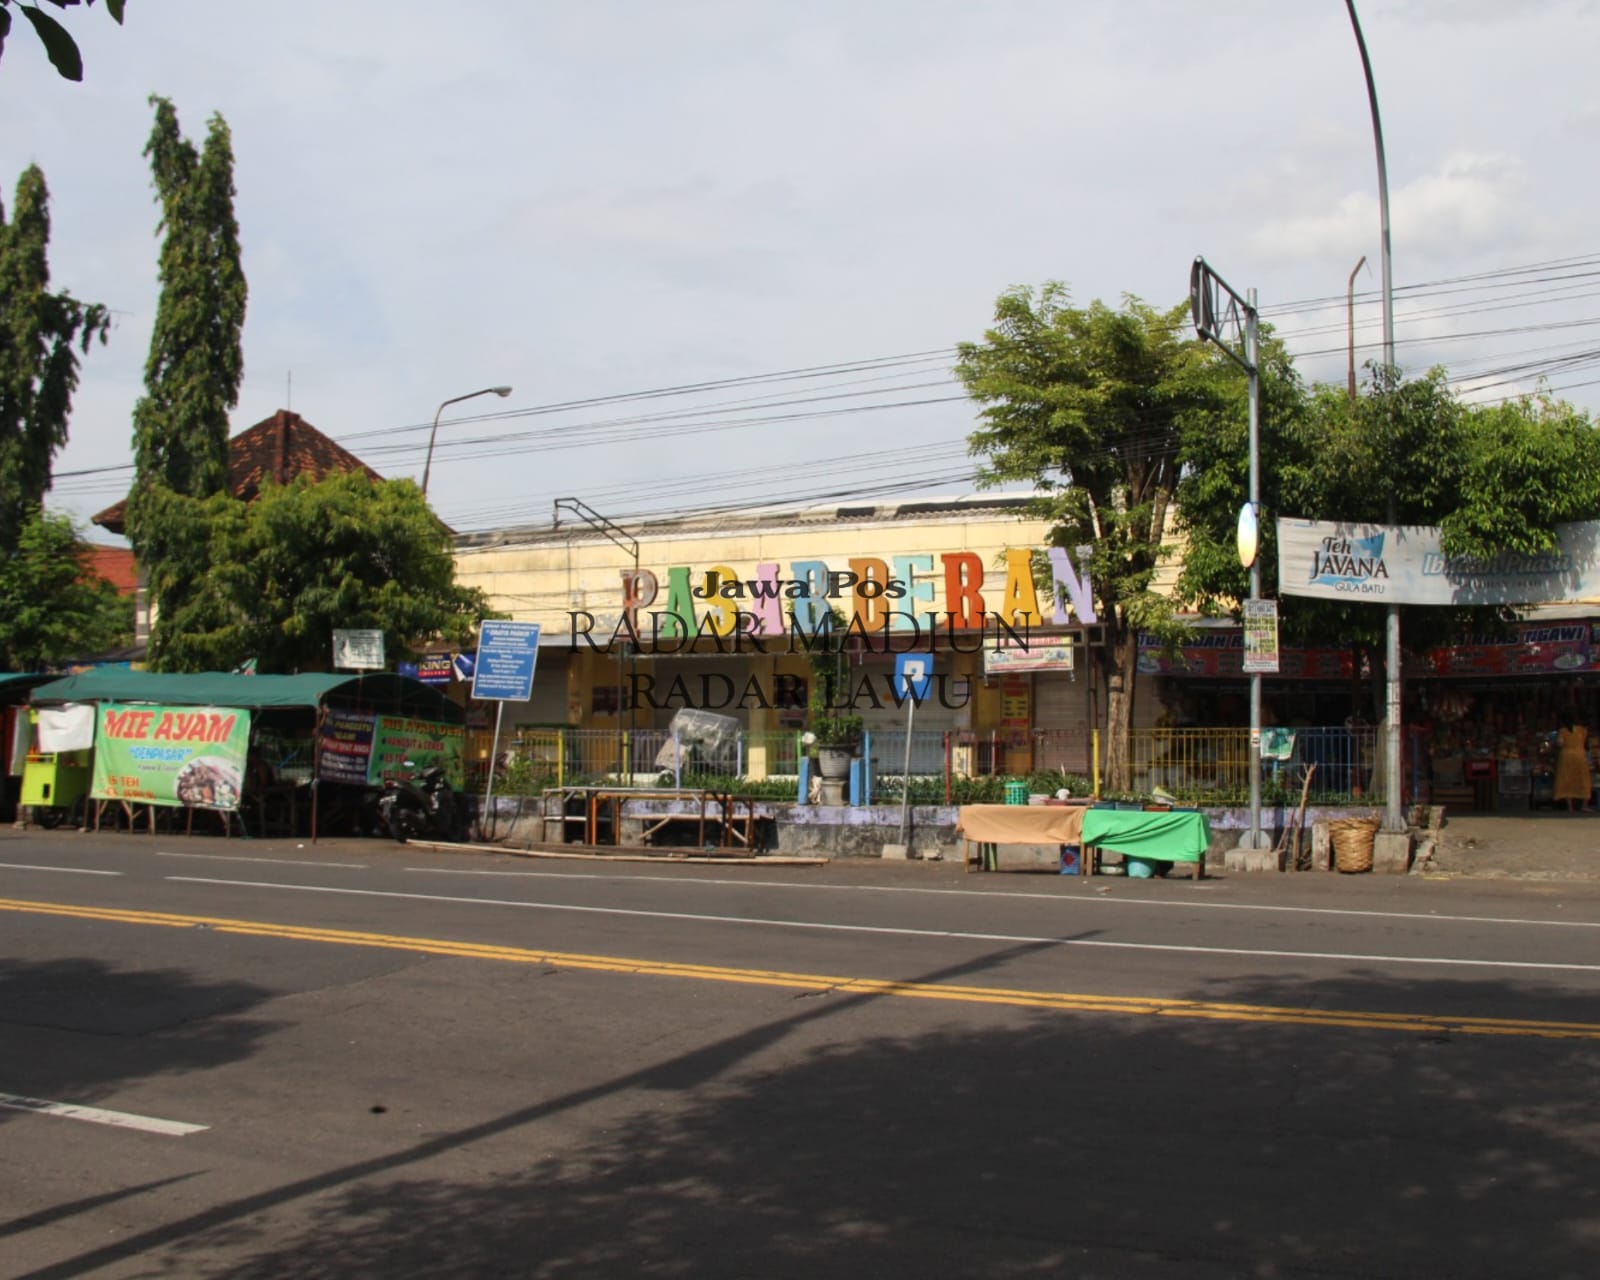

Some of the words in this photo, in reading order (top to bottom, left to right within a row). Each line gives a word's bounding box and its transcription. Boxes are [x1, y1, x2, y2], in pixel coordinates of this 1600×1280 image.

[1322, 536, 1350, 554] Teh
[1309, 551, 1389, 579] JAVANA
[620, 560, 833, 641] PASAR
[848, 545, 1098, 633] BERAN
[1335, 582, 1360, 592] GULA
[1361, 583, 1385, 594] BATU
[1525, 625, 1586, 643] NGAWI
[104, 710, 155, 740] MIE
[153, 711, 237, 744] AYAM
[120, 776, 140, 788] TEH
